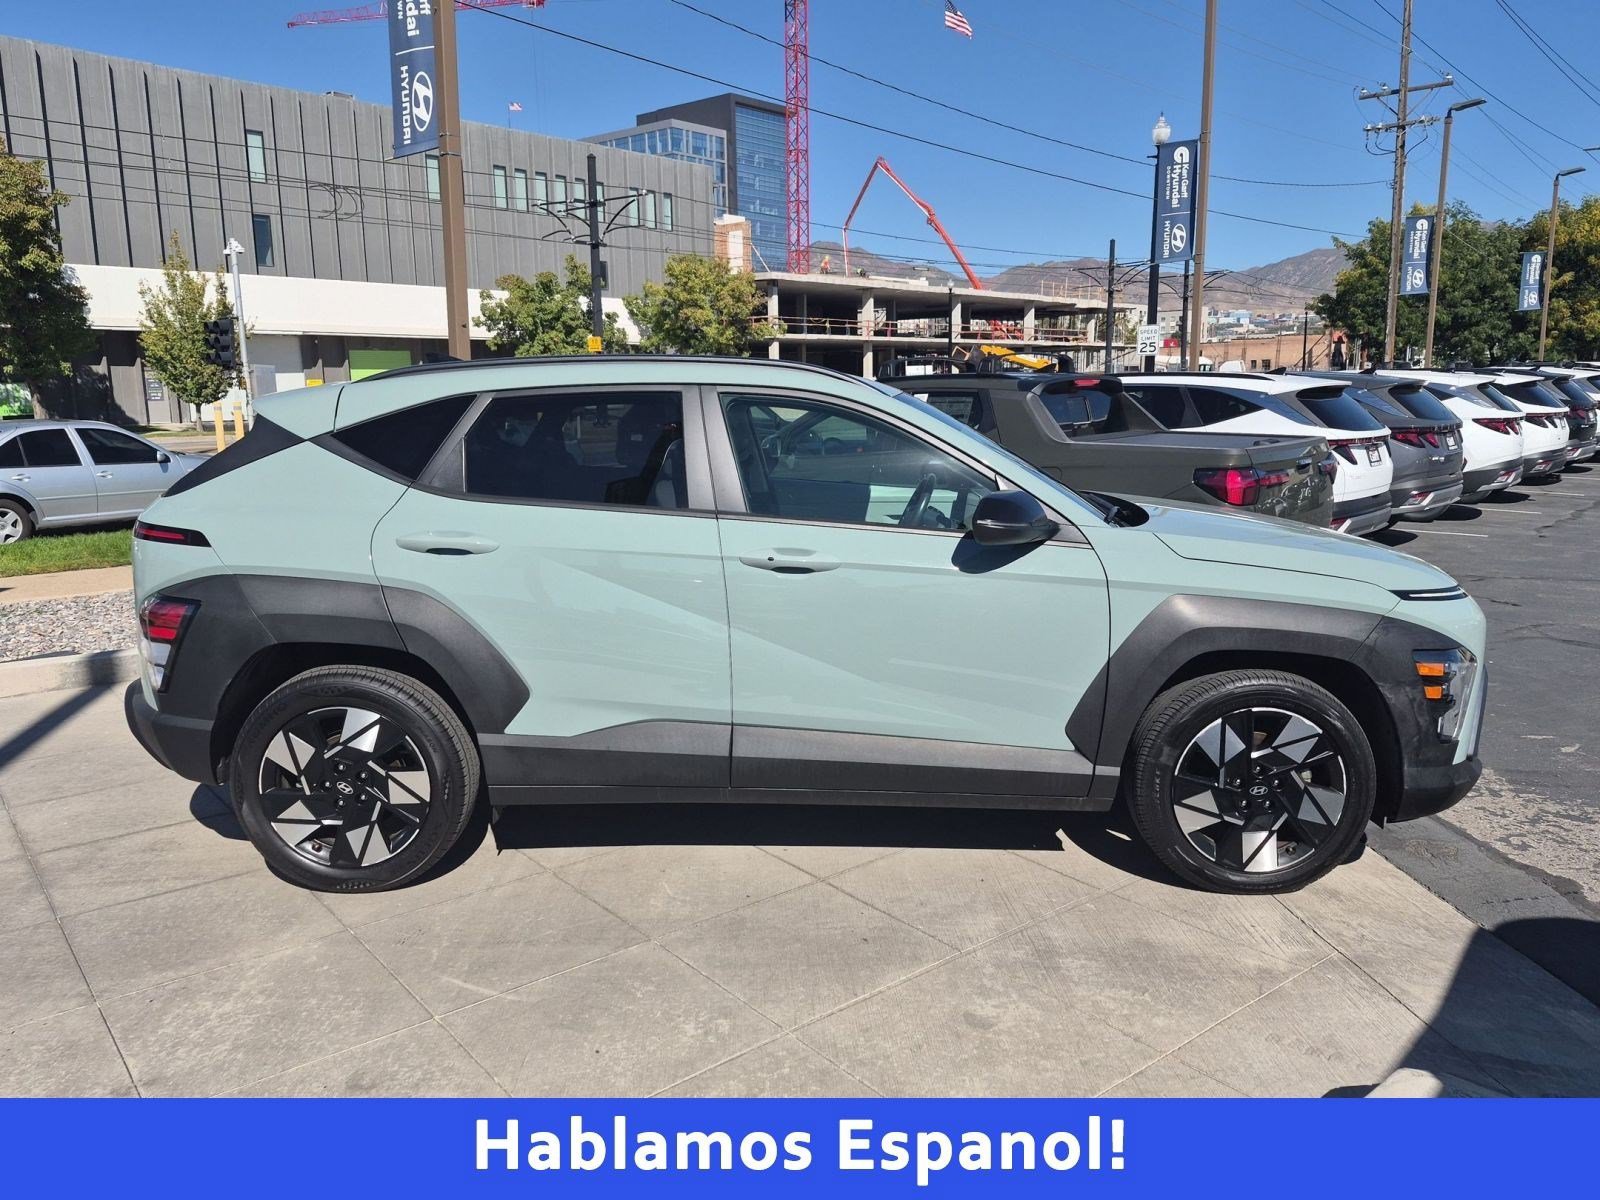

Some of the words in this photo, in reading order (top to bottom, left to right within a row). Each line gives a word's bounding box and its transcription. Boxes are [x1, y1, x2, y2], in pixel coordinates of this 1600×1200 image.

[400, 65, 411, 145] HYUNDAI
[1171, 164, 1181, 208] Hyundai
[1181, 163, 1189, 179] Ken
[1140, 341, 1157, 353] 25
